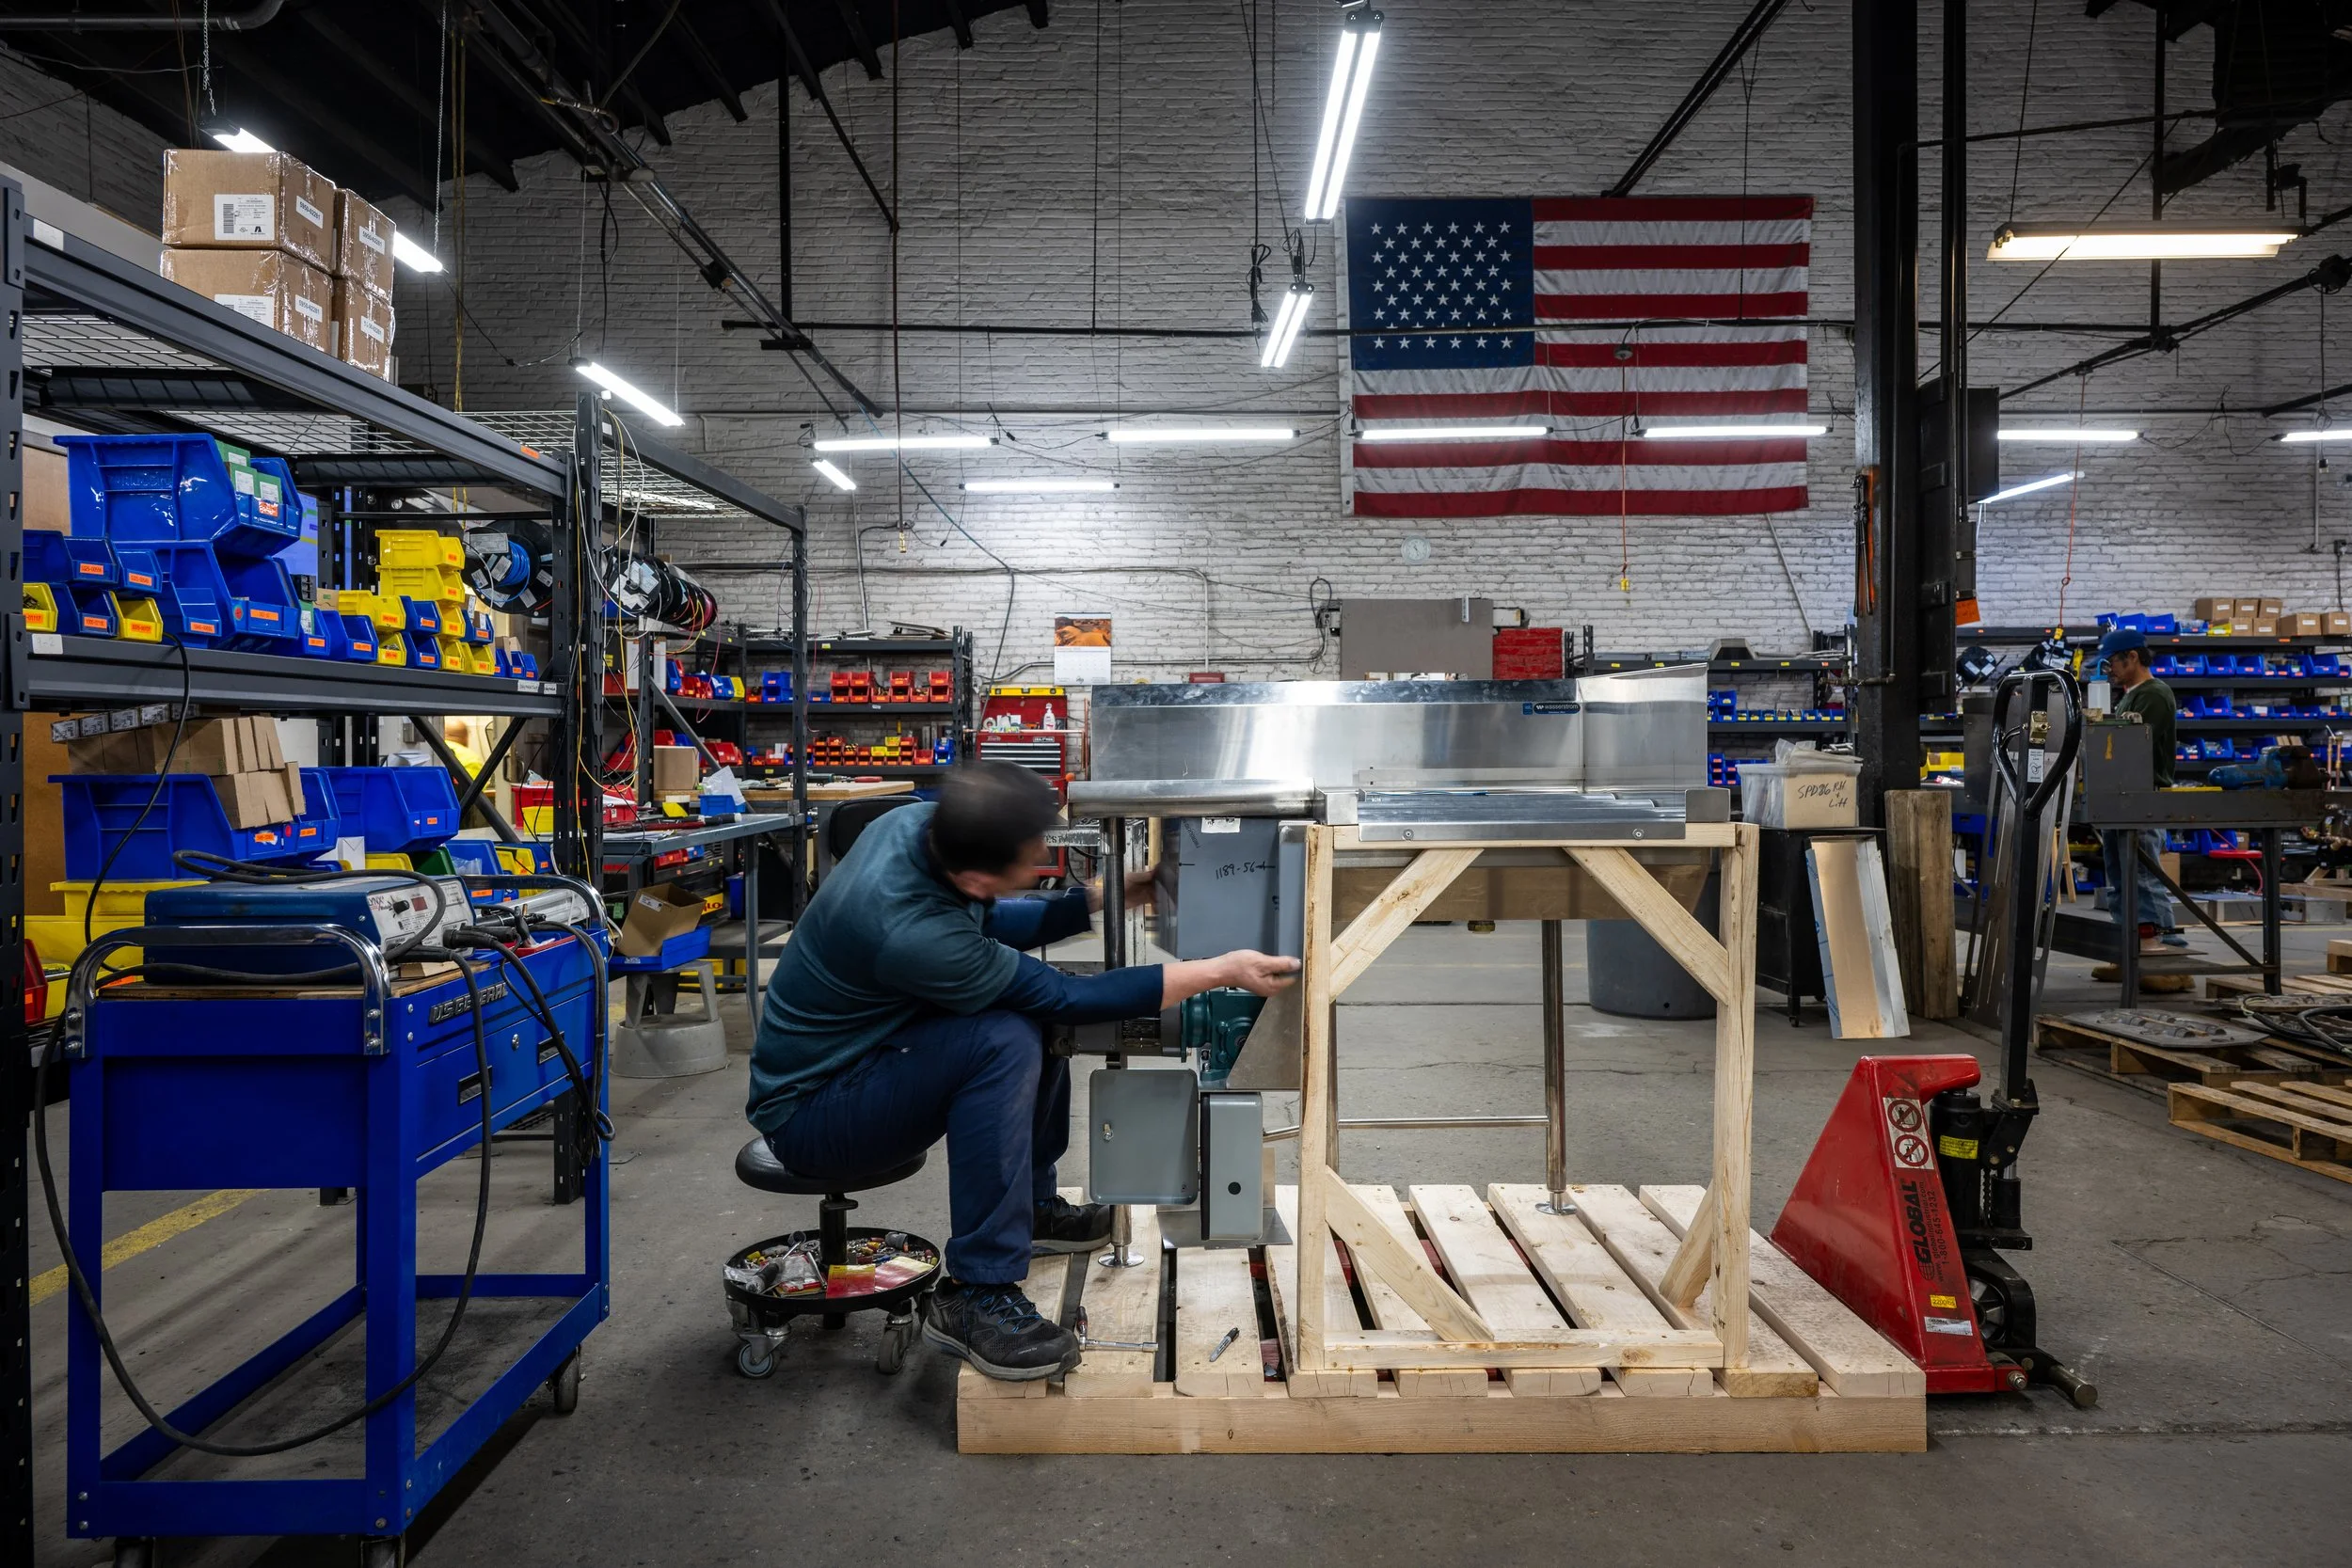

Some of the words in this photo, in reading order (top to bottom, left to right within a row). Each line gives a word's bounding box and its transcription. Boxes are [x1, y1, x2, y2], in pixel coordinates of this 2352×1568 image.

[1797, 783, 1832, 800] SPD86
[454, 982, 508, 1016] GEERAL
[1901, 1179, 1931, 1264] GLOBAL
[1927, 1190, 1950, 1265] 1-800-645-1232
